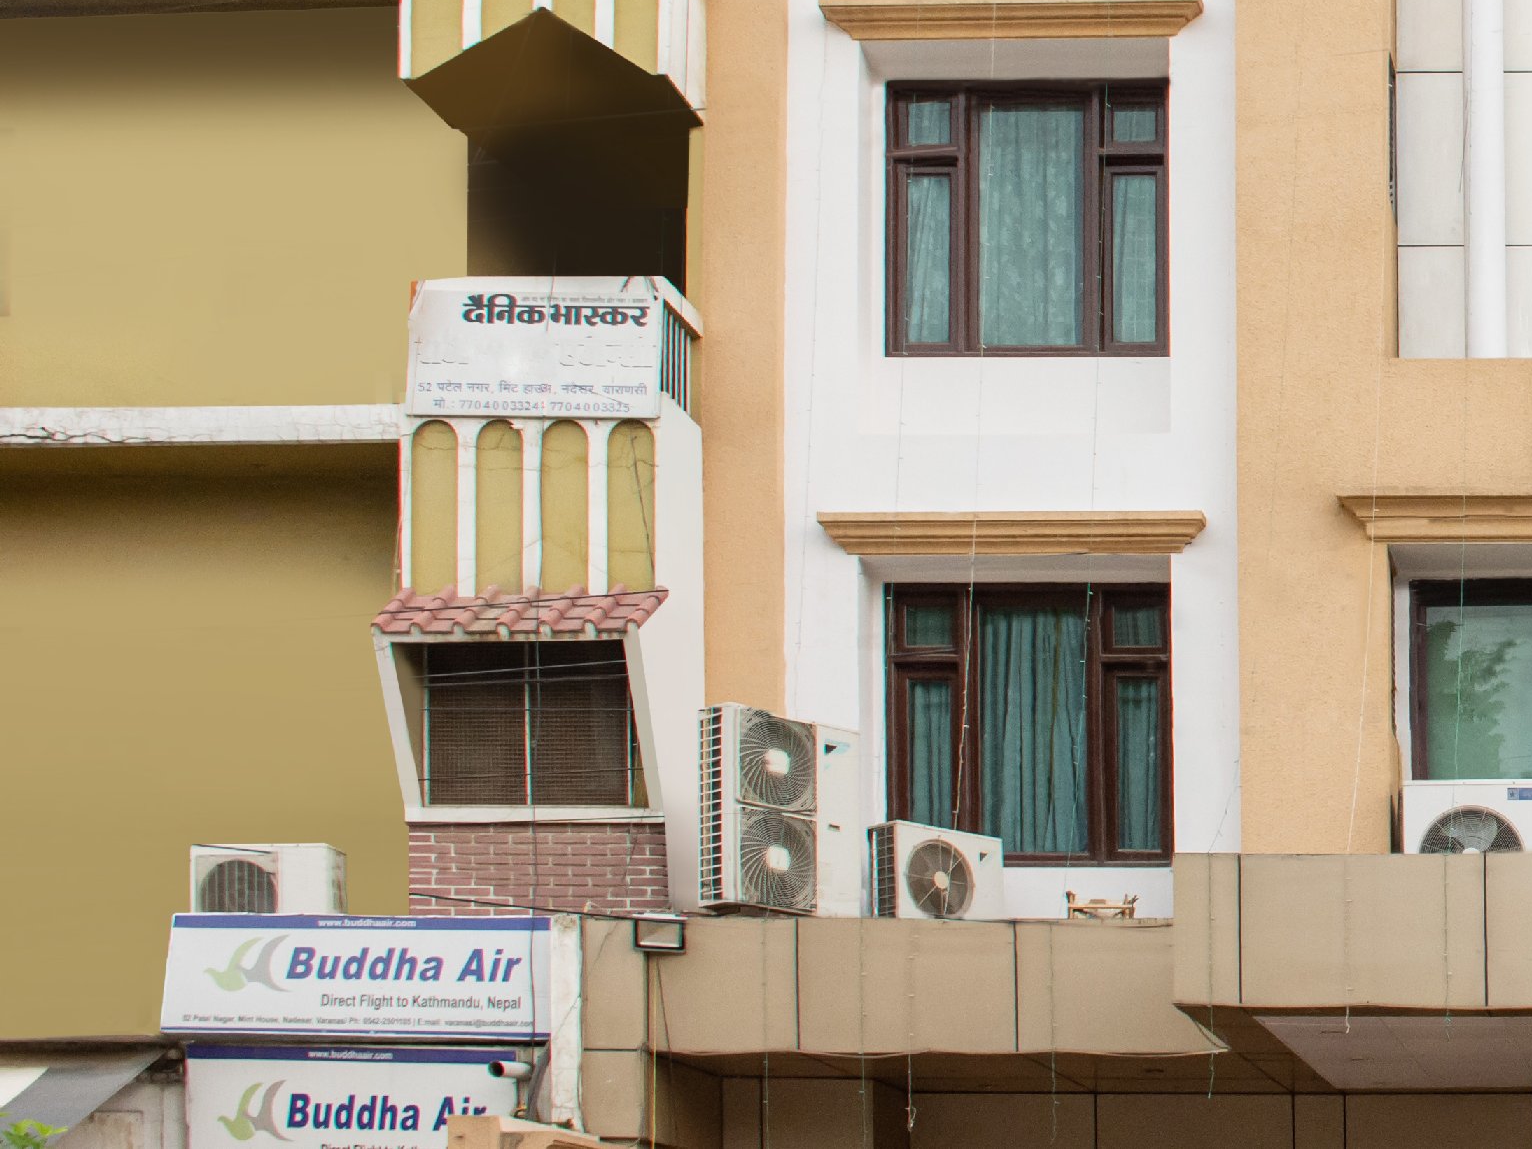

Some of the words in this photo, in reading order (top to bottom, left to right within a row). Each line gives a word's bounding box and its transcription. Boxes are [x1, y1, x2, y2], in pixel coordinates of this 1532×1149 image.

[462, 293, 546, 325] दैनिक
[549, 304, 650, 327] भास्कर
[285, 946, 445, 982] Buddha
[455, 948, 523, 983] Air
[320, 993, 356, 1007] Direct
[359, 994, 394, 1011] Flight
[397, 996, 409, 1007] to
[412, 995, 484, 1011] Kathmandu,
[487, 996, 522, 1012] Nepal
[286, 1093, 421, 1131] Buddha
